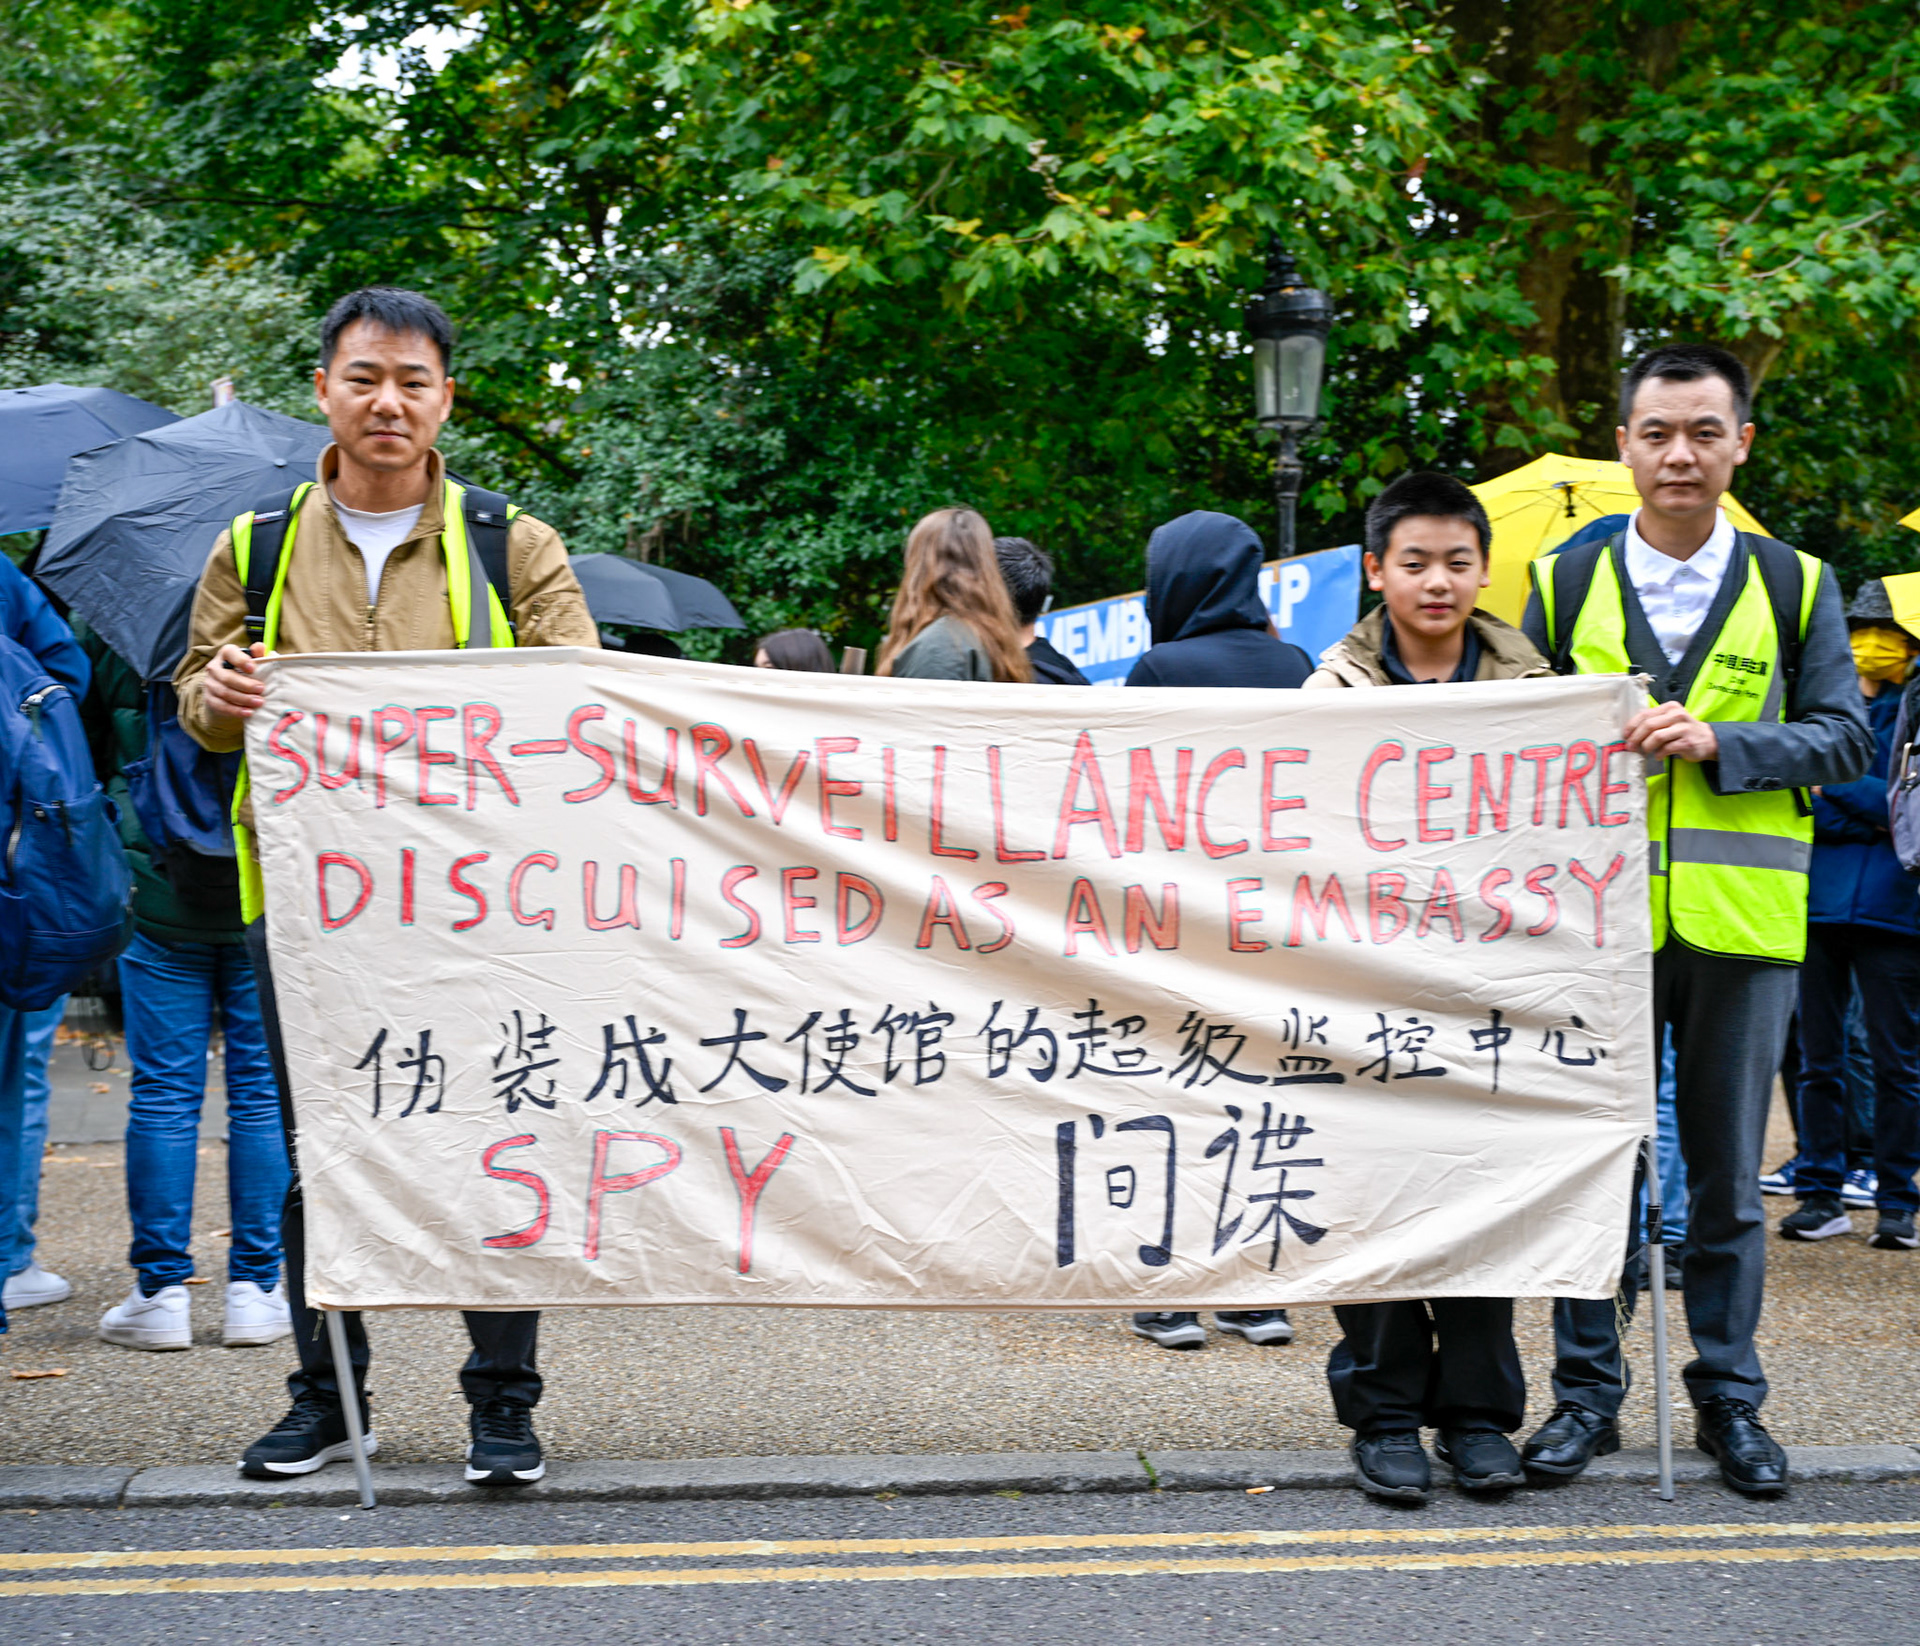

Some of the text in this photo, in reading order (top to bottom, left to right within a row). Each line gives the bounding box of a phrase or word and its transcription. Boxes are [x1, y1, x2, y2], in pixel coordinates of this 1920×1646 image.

[267, 702, 1631, 863] SUPER-SURVEILLANCE CENTRE
[316, 846, 1627, 957] DISGUISED AS AN EMBASSY
[481, 1125, 797, 1276] SPY
[1056, 1101, 1328, 1271] 间谍
